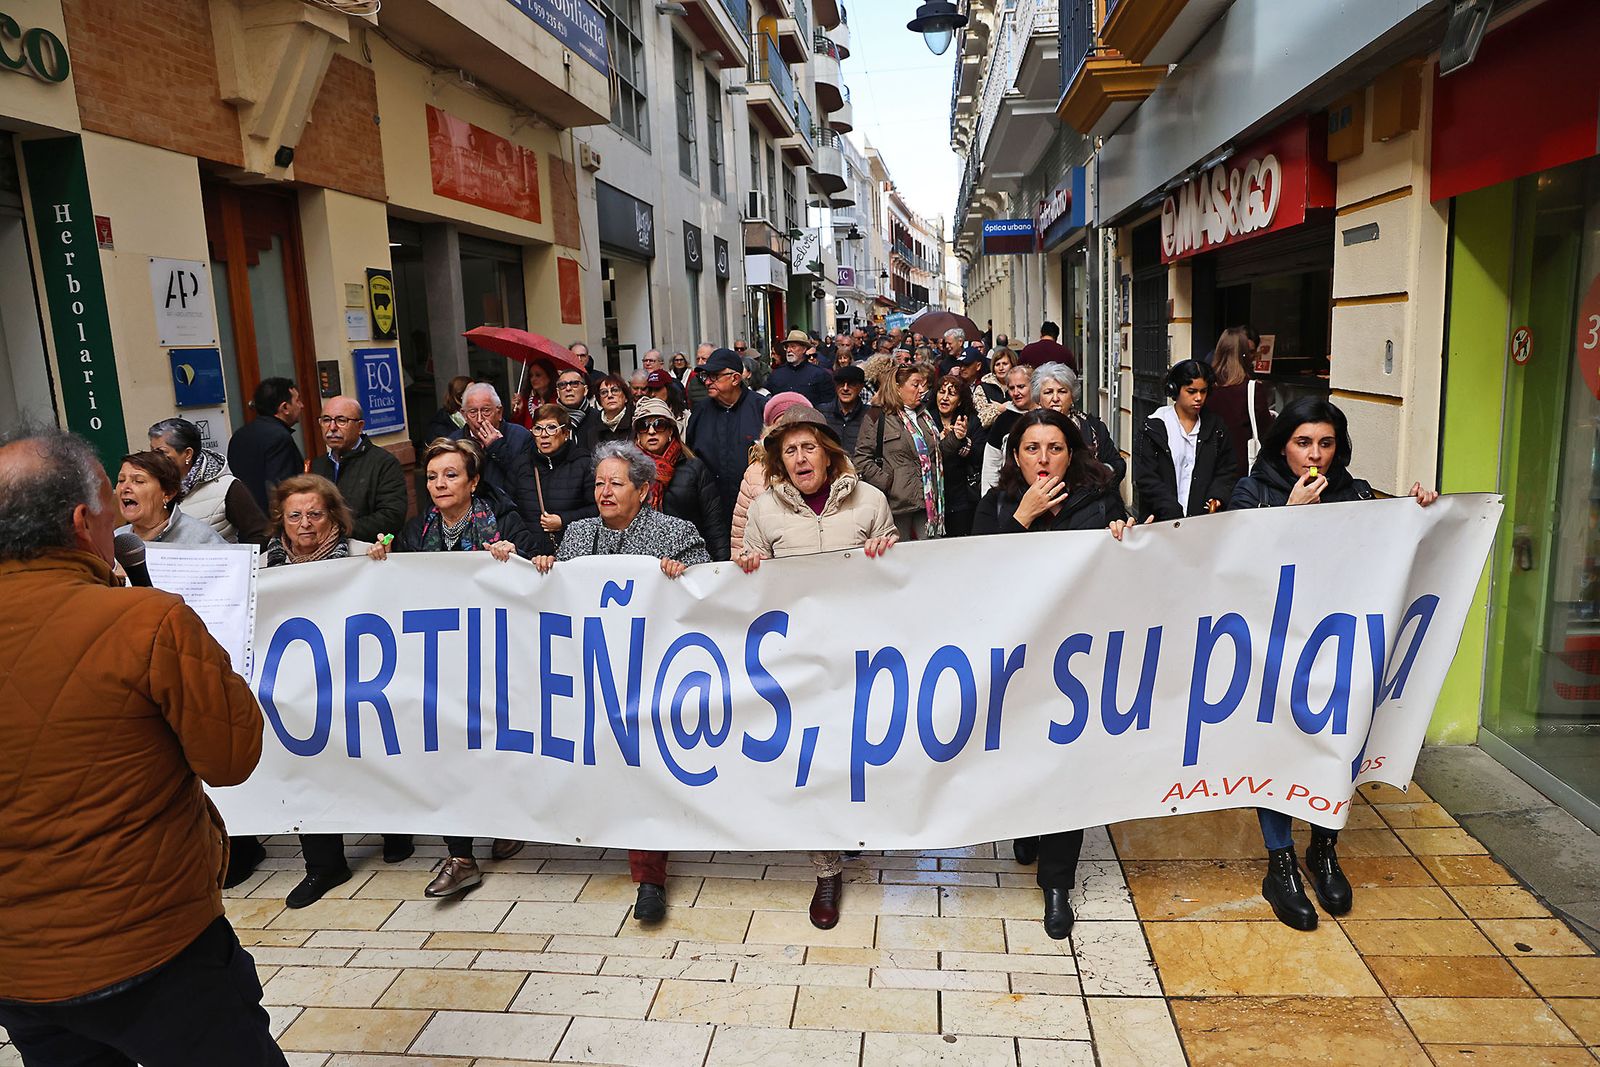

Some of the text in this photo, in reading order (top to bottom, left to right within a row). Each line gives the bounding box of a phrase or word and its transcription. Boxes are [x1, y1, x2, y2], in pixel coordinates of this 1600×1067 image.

[984, 223, 1032, 233] óptica urbano
[53, 203, 103, 430] Herbolario
[364, 361, 394, 394] EQ
[368, 394, 396, 409] Fincas
[256, 564, 1441, 804] ORTILEÑ@S, por su playa
[1161, 776, 1274, 803] AA.VV.
